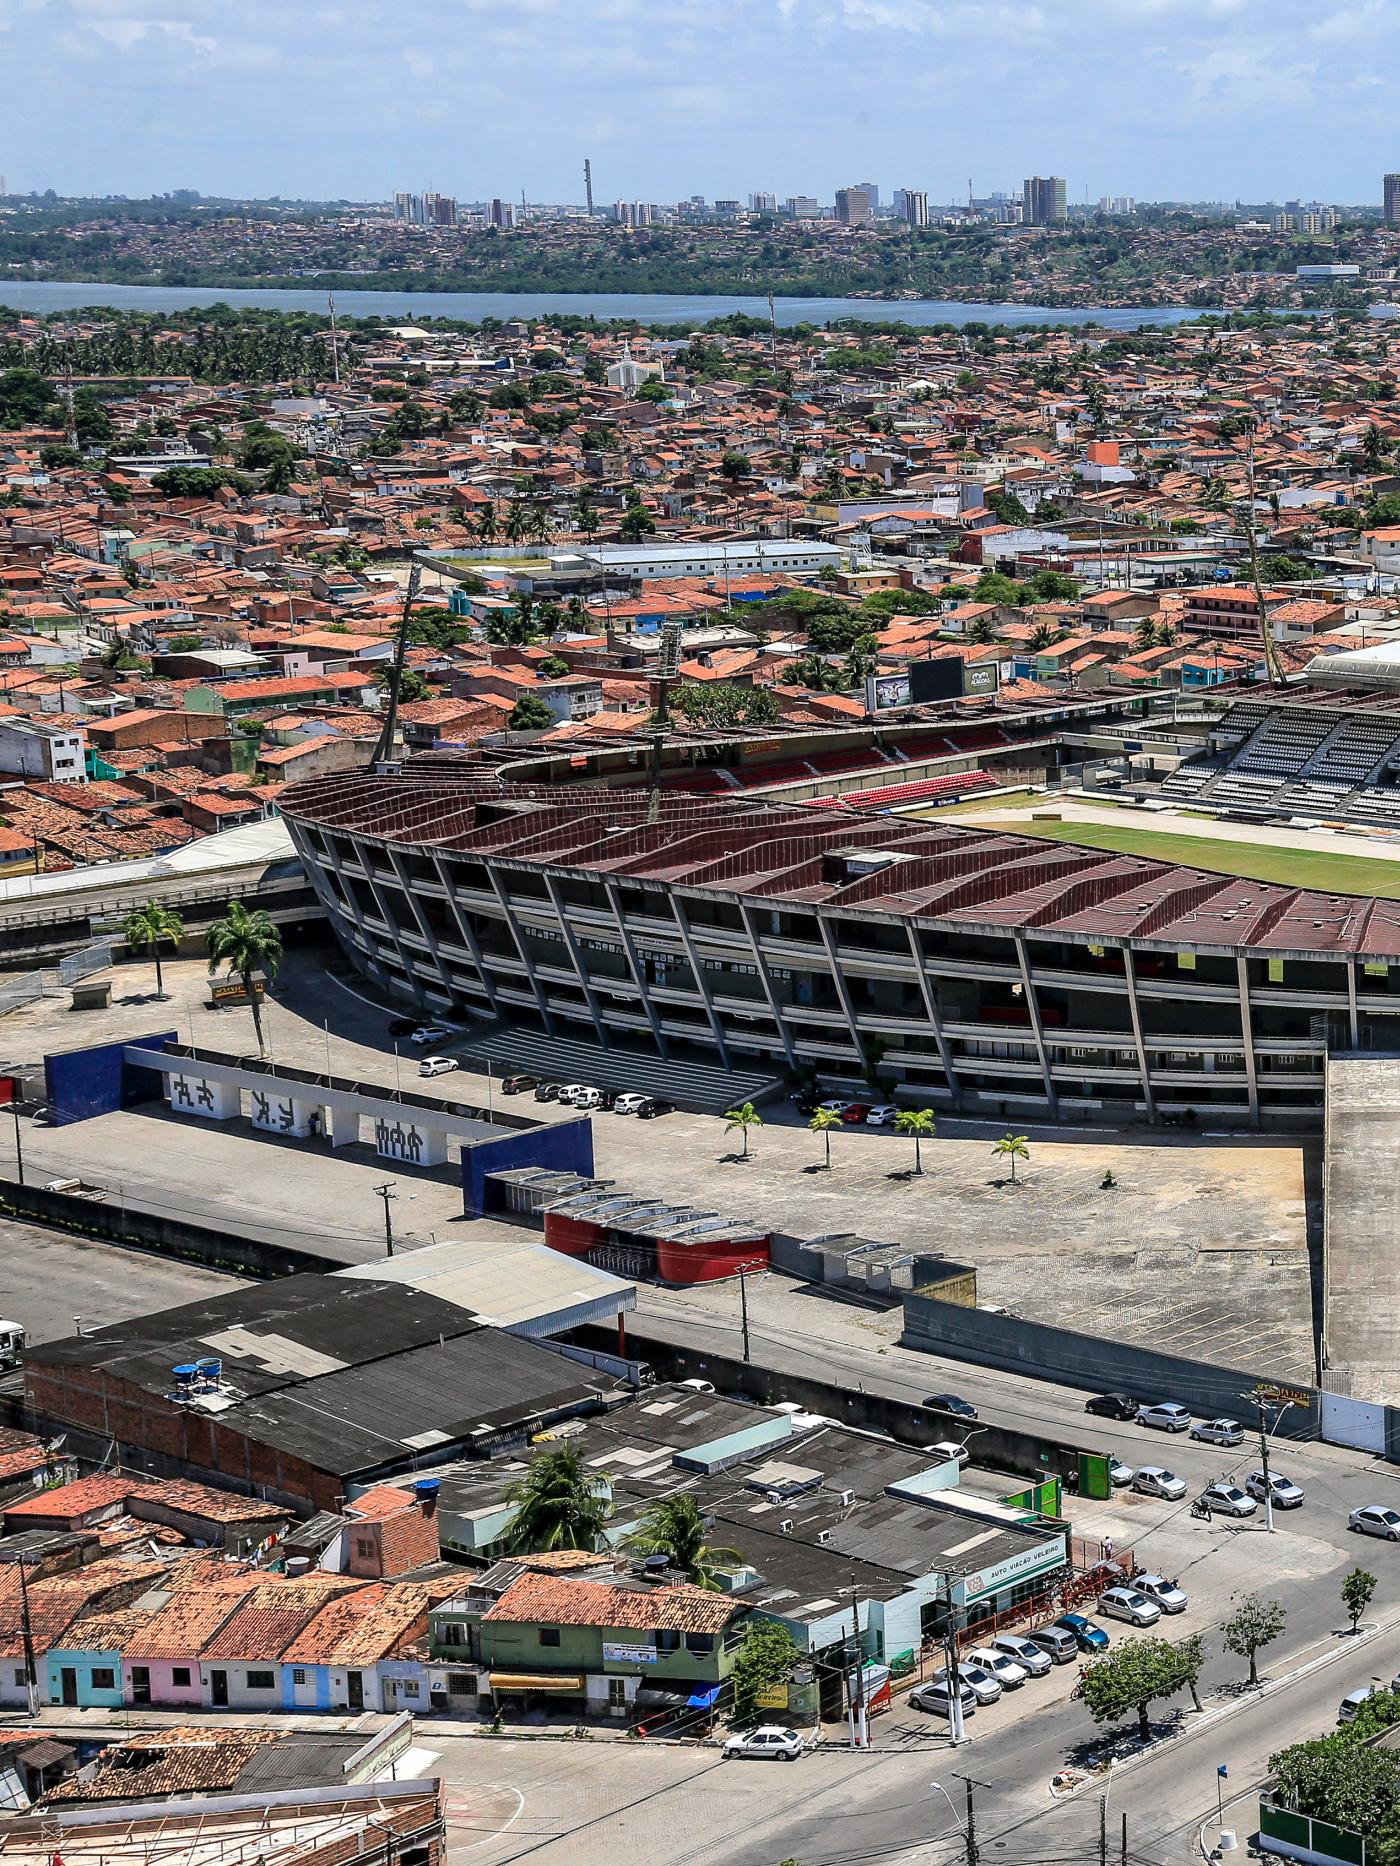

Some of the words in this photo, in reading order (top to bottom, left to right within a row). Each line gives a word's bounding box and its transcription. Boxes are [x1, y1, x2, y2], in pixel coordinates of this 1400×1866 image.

[991, 1567, 1007, 1578] AUTO
[1010, 1555, 1031, 1571] VIAÇÃO
[1033, 1545, 1059, 1560] VELEIRO
